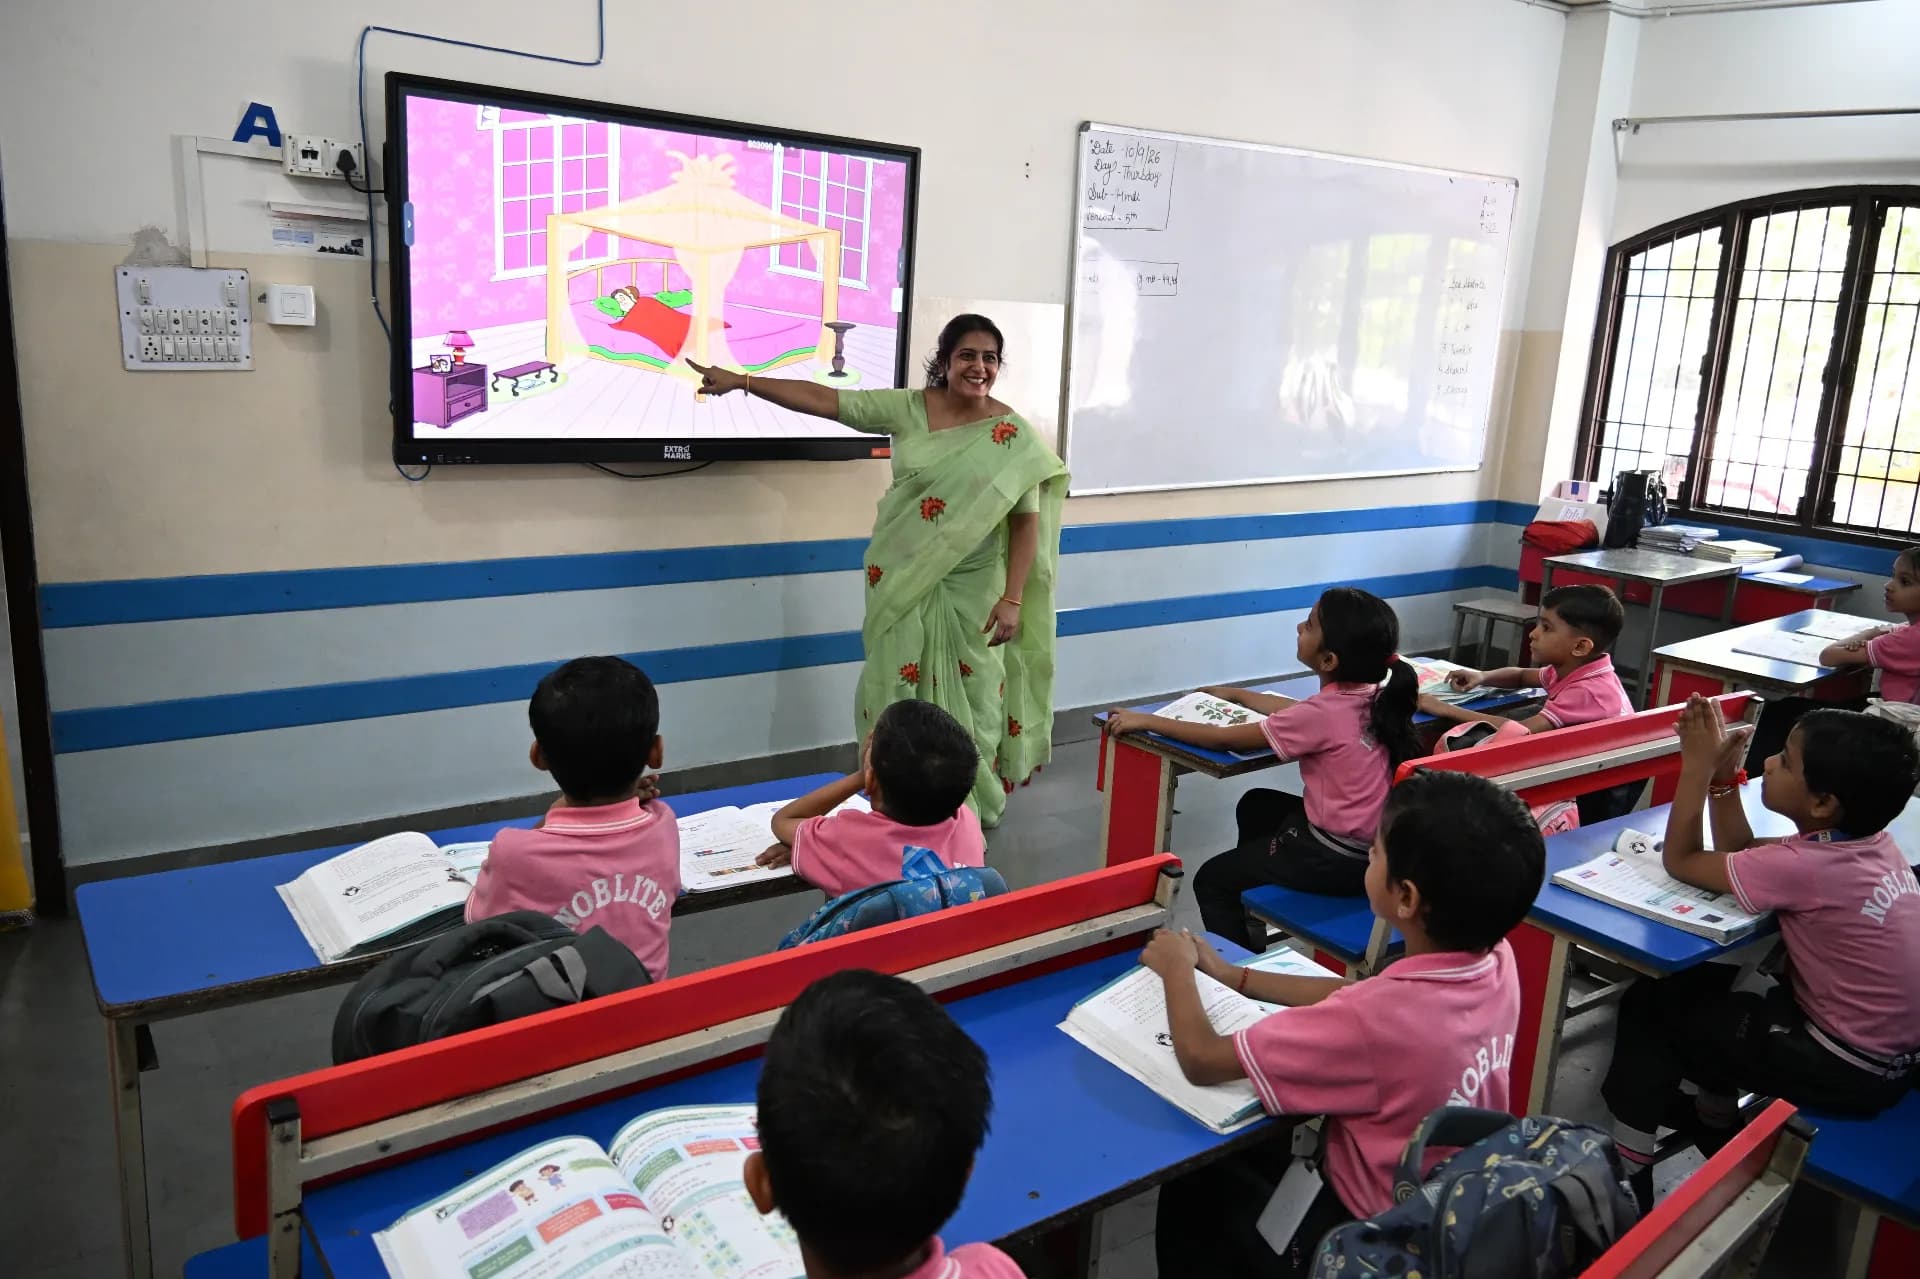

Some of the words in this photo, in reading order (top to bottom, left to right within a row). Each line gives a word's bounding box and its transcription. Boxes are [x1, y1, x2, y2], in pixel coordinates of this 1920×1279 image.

[232, 101, 281, 148] A
[664, 452, 691, 460] MARKS
[553, 873, 667, 932] NOBLITE
